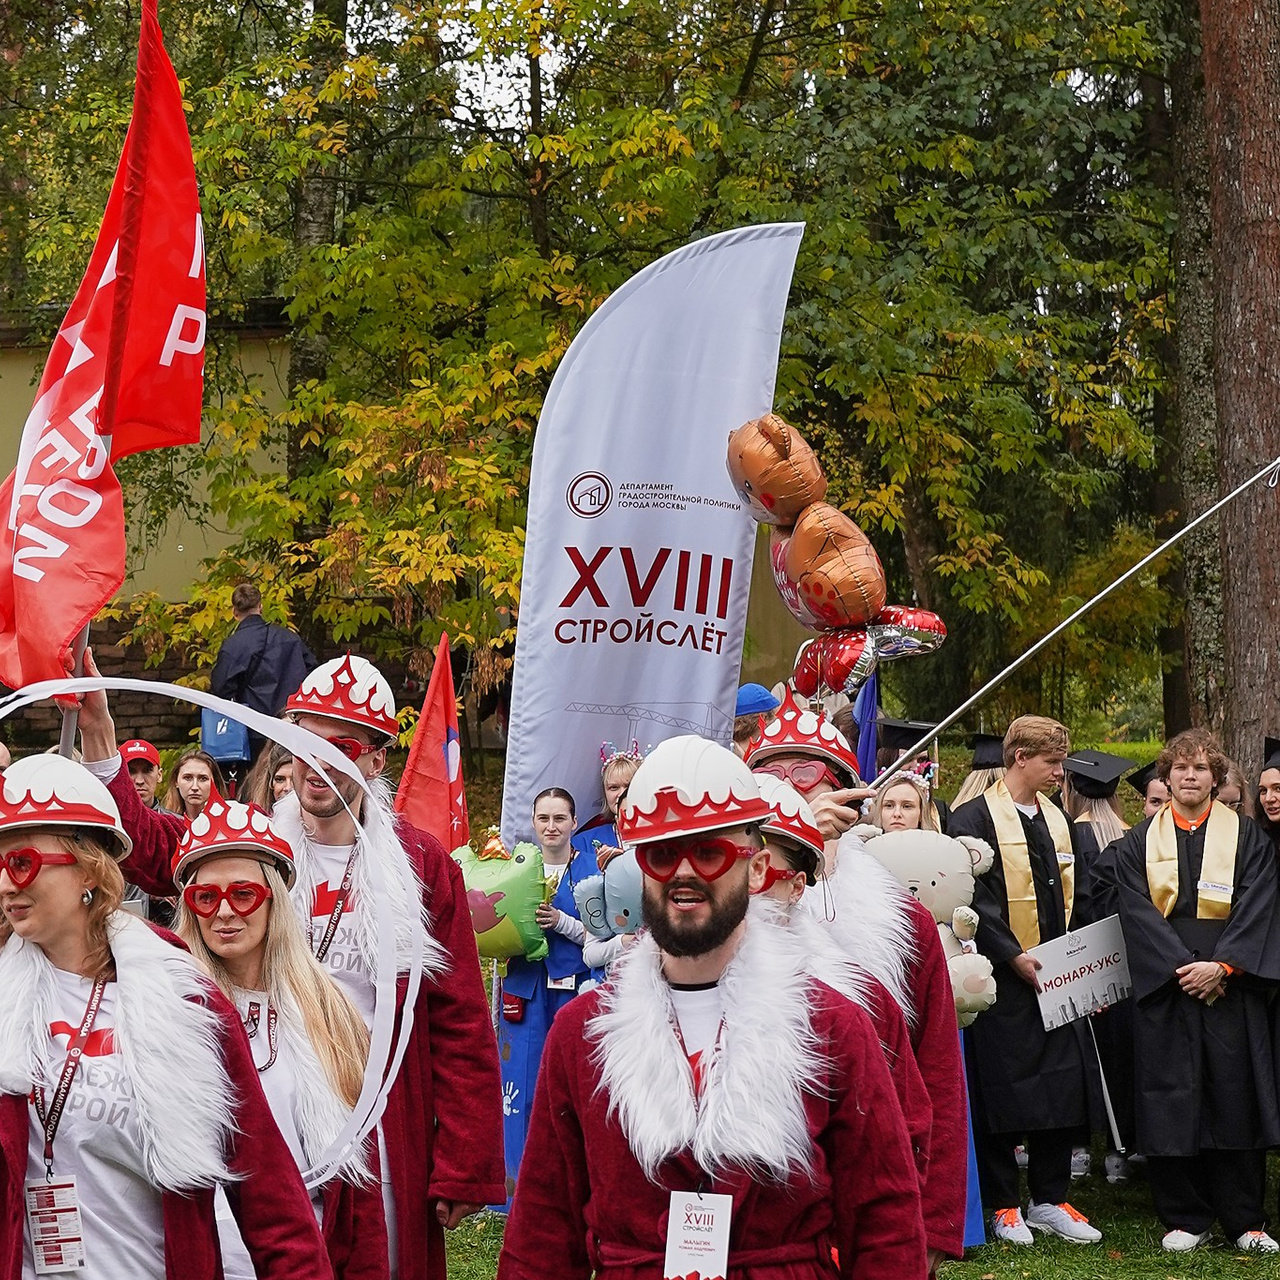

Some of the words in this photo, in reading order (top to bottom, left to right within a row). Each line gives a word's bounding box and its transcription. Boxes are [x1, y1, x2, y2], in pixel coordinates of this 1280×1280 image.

[618, 492, 702, 504] ГРАДОСТРОИТЕЛЬНОЙ
[703, 498, 741, 511] ПОЛИТИКИ
[619, 482, 674, 491] ДЕПАРТАМЕНТ
[618, 501, 650, 509] ГОРОДА
[651, 501, 687, 511] МОСКВЫ
[558, 546, 734, 620] XVIII
[554, 612, 728, 655] СТРОЙСЛЁТ
[1043, 952, 1122, 993] МОНАРХ-УКС
[54, 1067, 73, 1110] ФУНДАМЕНТ
[46, 1108, 60, 1142] ГОРОДА
[684, 1212, 714, 1226] XVIII
